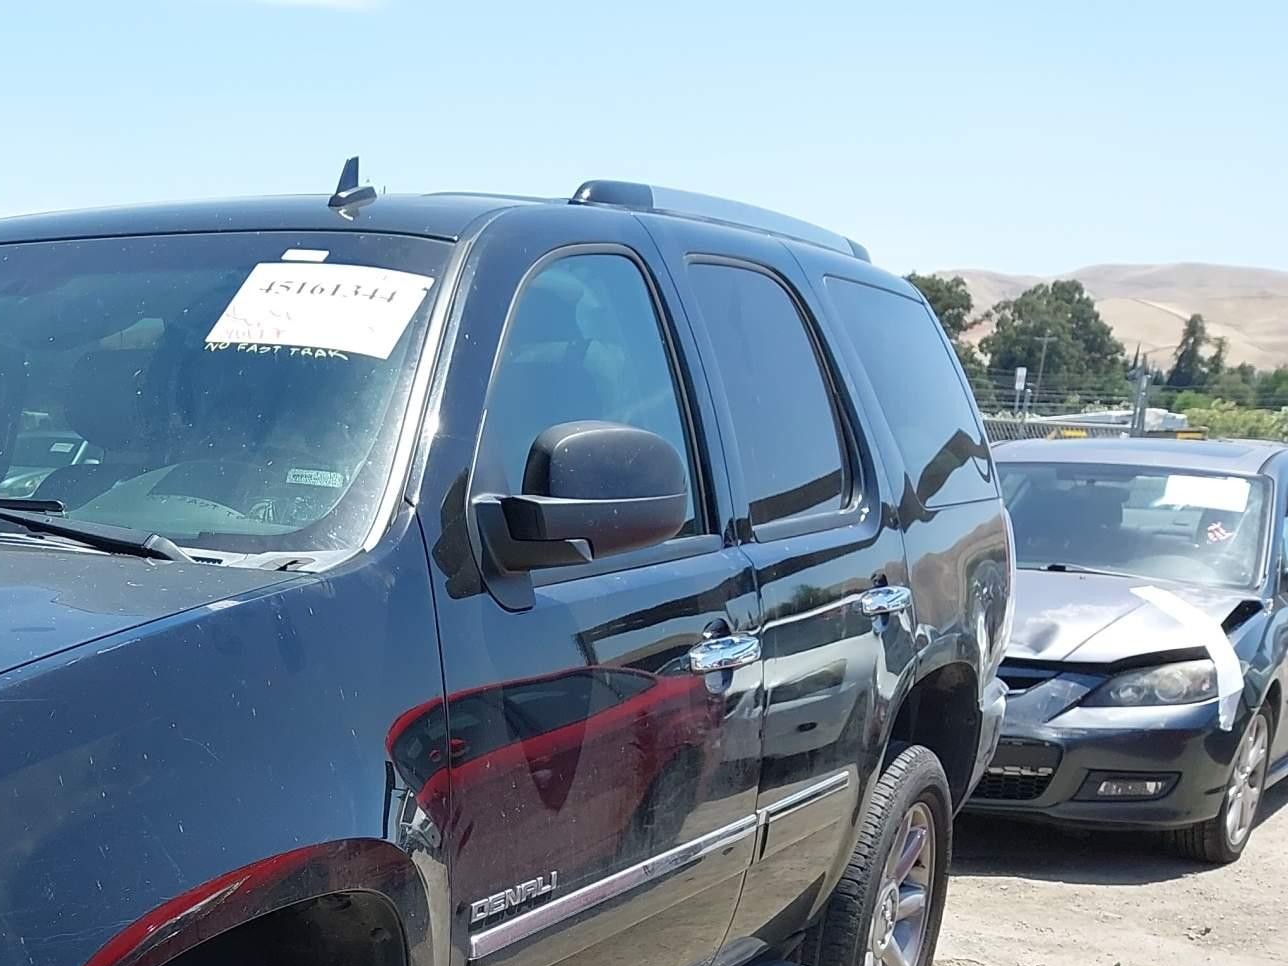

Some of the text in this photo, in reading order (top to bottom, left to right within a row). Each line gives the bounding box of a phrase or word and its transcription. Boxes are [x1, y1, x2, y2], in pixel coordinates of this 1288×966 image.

[259, 280, 398, 304] 45161344
[204, 340, 350, 361] NO FAST TRAK
[470, 870, 558, 924] DENALI
